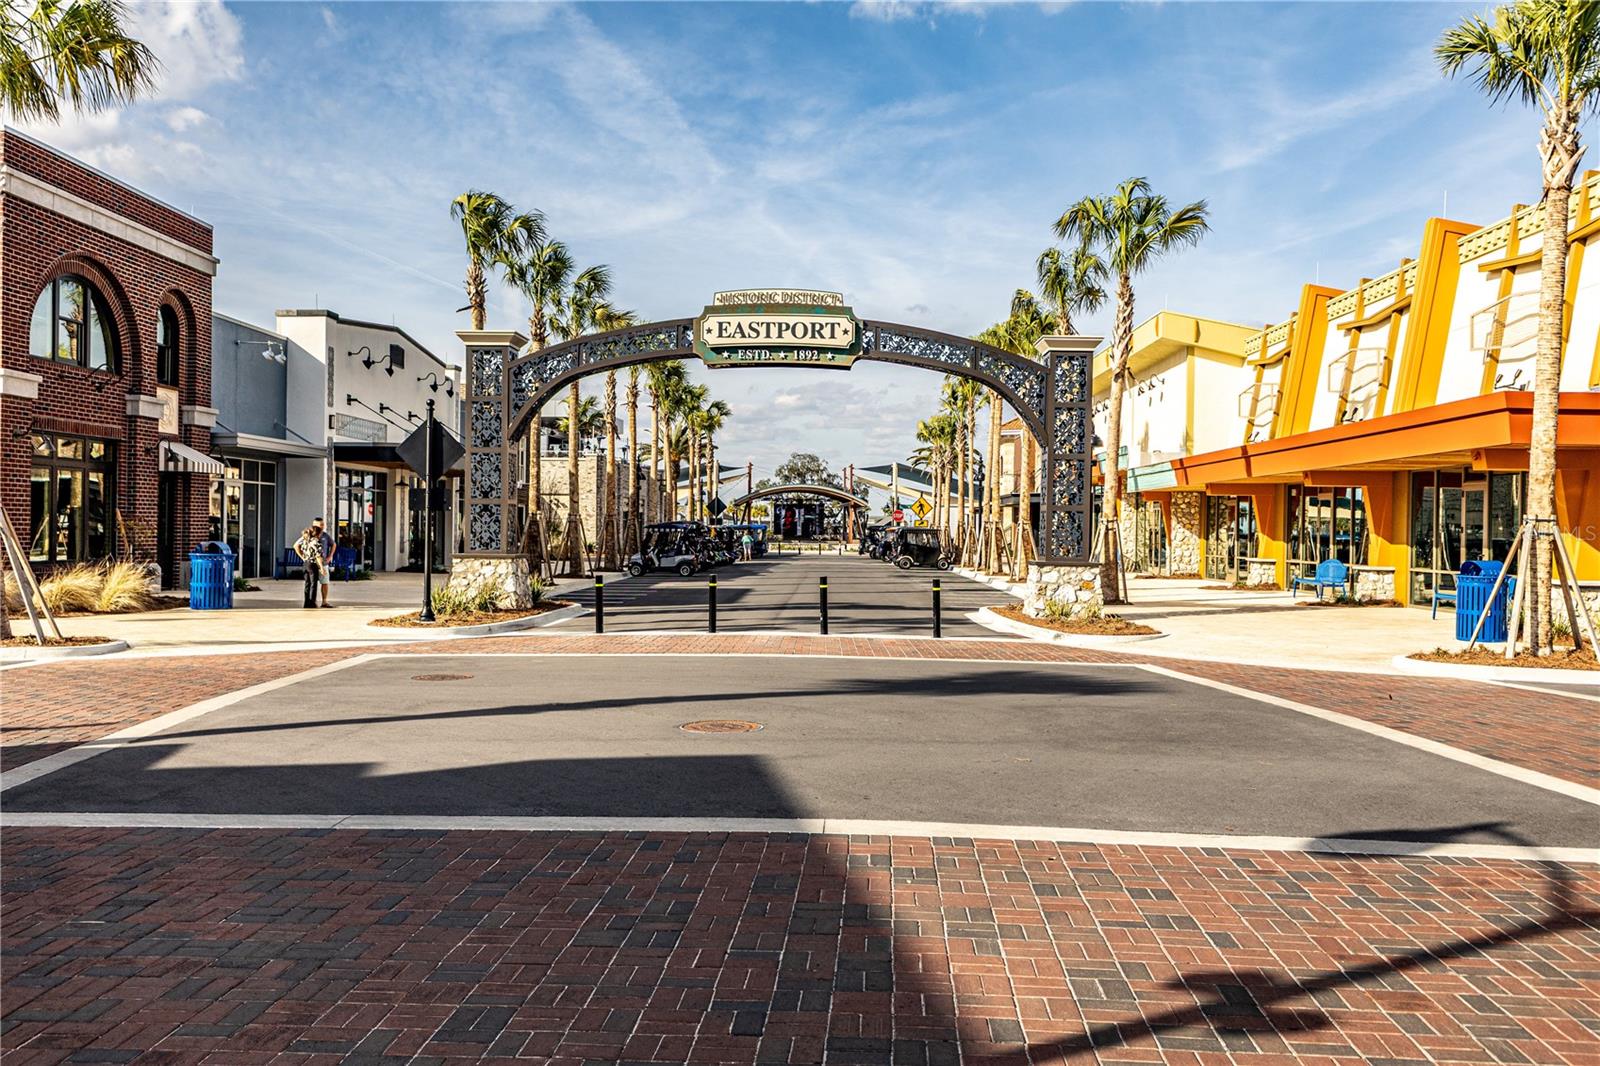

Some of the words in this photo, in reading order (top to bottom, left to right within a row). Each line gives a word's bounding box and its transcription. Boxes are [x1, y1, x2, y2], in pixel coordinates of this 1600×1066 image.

[720, 291, 779, 304] HISTORIC
[781, 291, 838, 305] DISTRICT
[717, 321, 841, 339] EASTPORT
[737, 349, 773, 360] ESTD.
[793, 349, 819, 360] 1892
